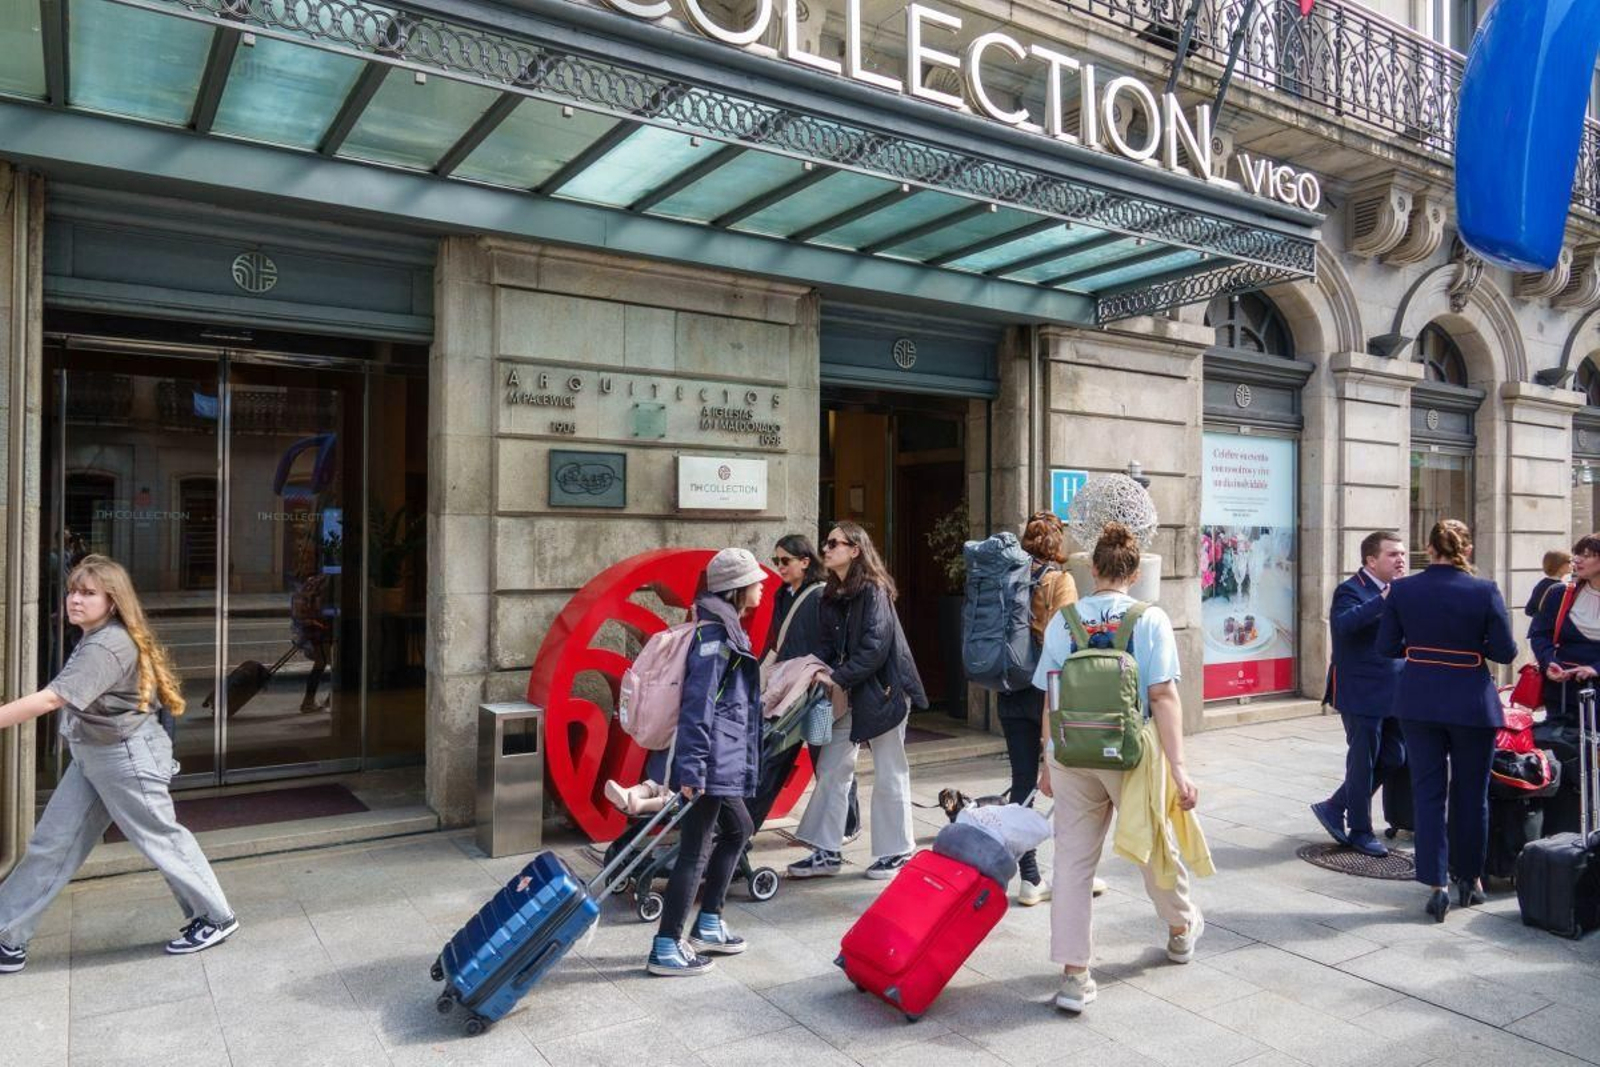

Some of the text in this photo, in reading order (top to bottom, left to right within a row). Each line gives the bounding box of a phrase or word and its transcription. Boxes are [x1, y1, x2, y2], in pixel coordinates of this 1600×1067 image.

[602, 0, 1321, 210] LLECTION VIGO
[711, 407, 753, 420] IGLESIAS
[718, 420, 781, 434] MALDONADO
[703, 483, 758, 494] COLLECTION
[1062, 477, 1077, 503] H
[115, 511, 190, 520] COLLECTION
